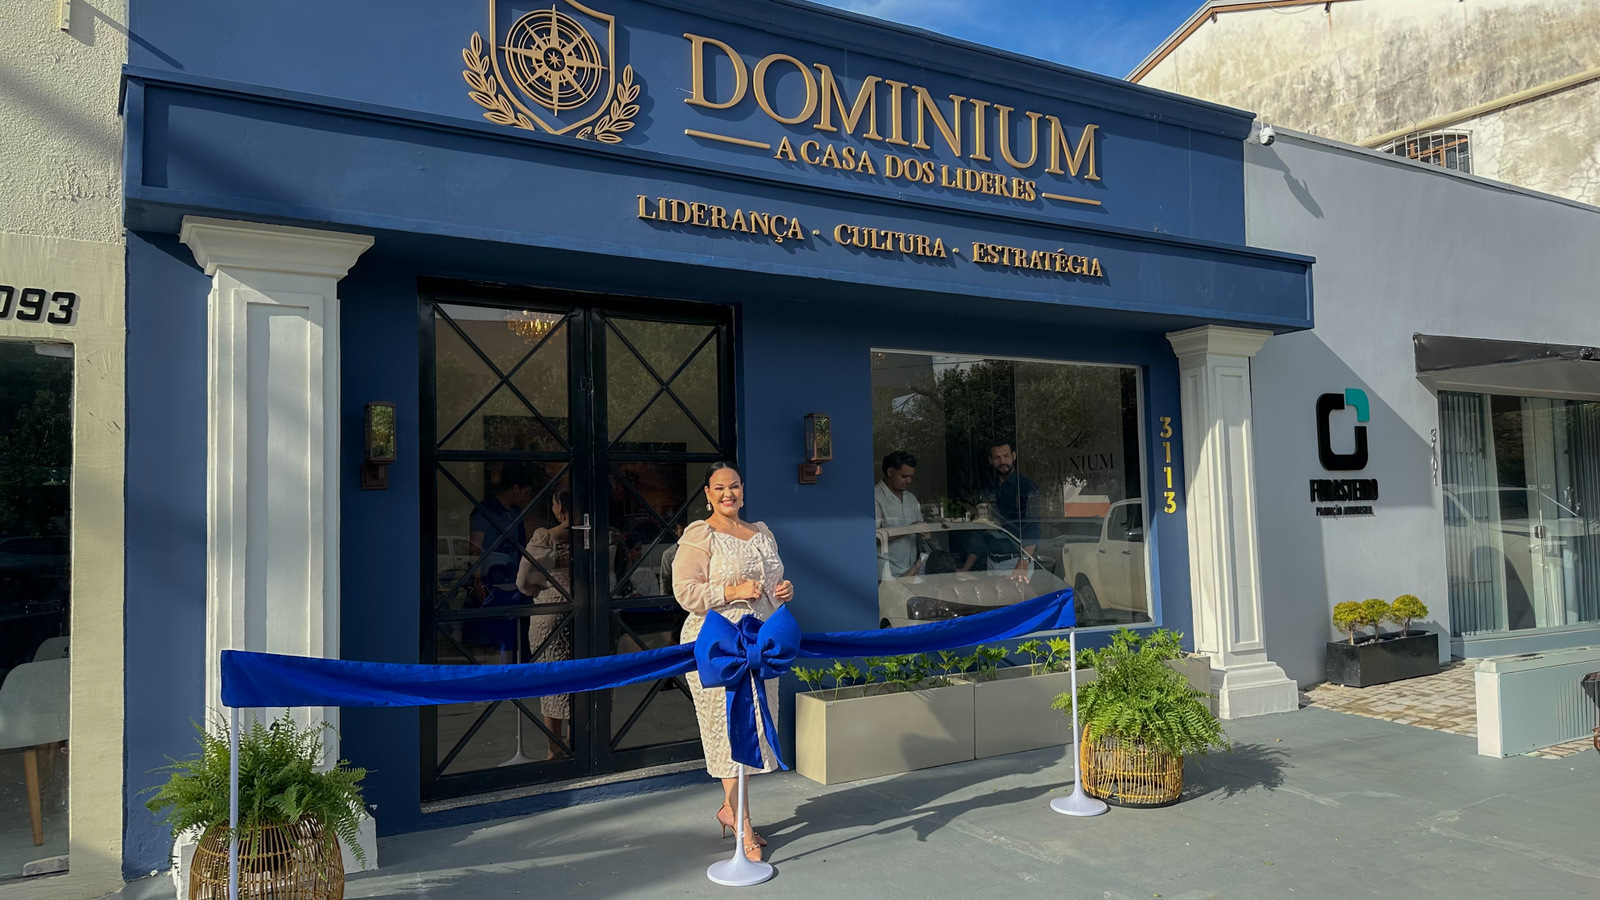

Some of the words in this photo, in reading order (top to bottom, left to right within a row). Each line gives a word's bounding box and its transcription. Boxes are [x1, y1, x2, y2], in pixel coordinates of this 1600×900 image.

[683, 32, 1101, 181] DOMINIUM
[774, 136, 797, 162] A
[800, 140, 876, 175] CASA
[885, 154, 935, 184] DOS
[940, 164, 1036, 202] LIDERES
[636, 194, 805, 243] LIDERANÇA
[833, 223, 947, 258] CULTURA
[971, 241, 1103, 277] ESTRATÉGIA
[1159, 416, 1177, 514] 3113
